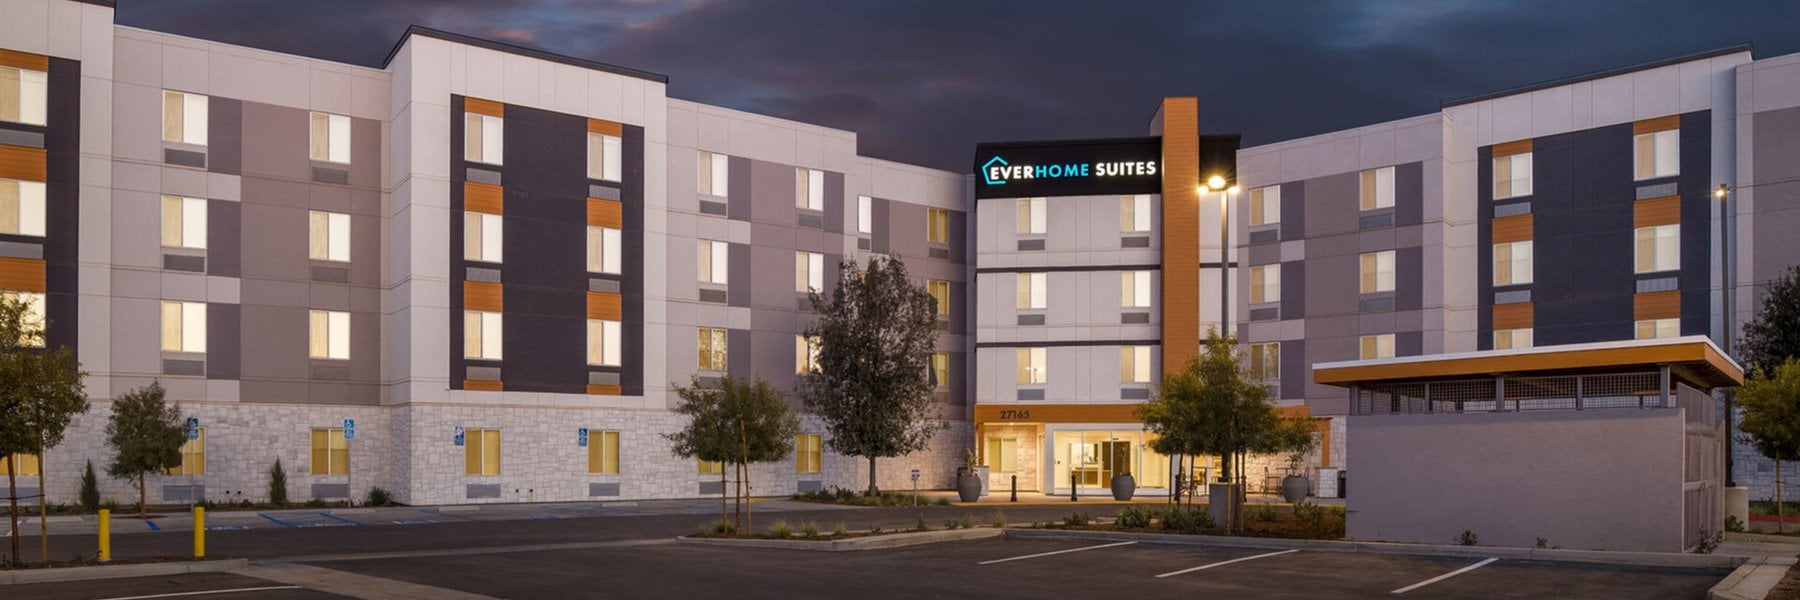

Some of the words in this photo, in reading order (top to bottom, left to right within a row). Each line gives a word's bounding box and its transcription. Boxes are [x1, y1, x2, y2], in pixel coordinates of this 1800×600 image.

[990, 164, 1089, 180] EVERHOME
[1095, 161, 1156, 176] SUITES
[1000, 410, 1030, 419] 27165
